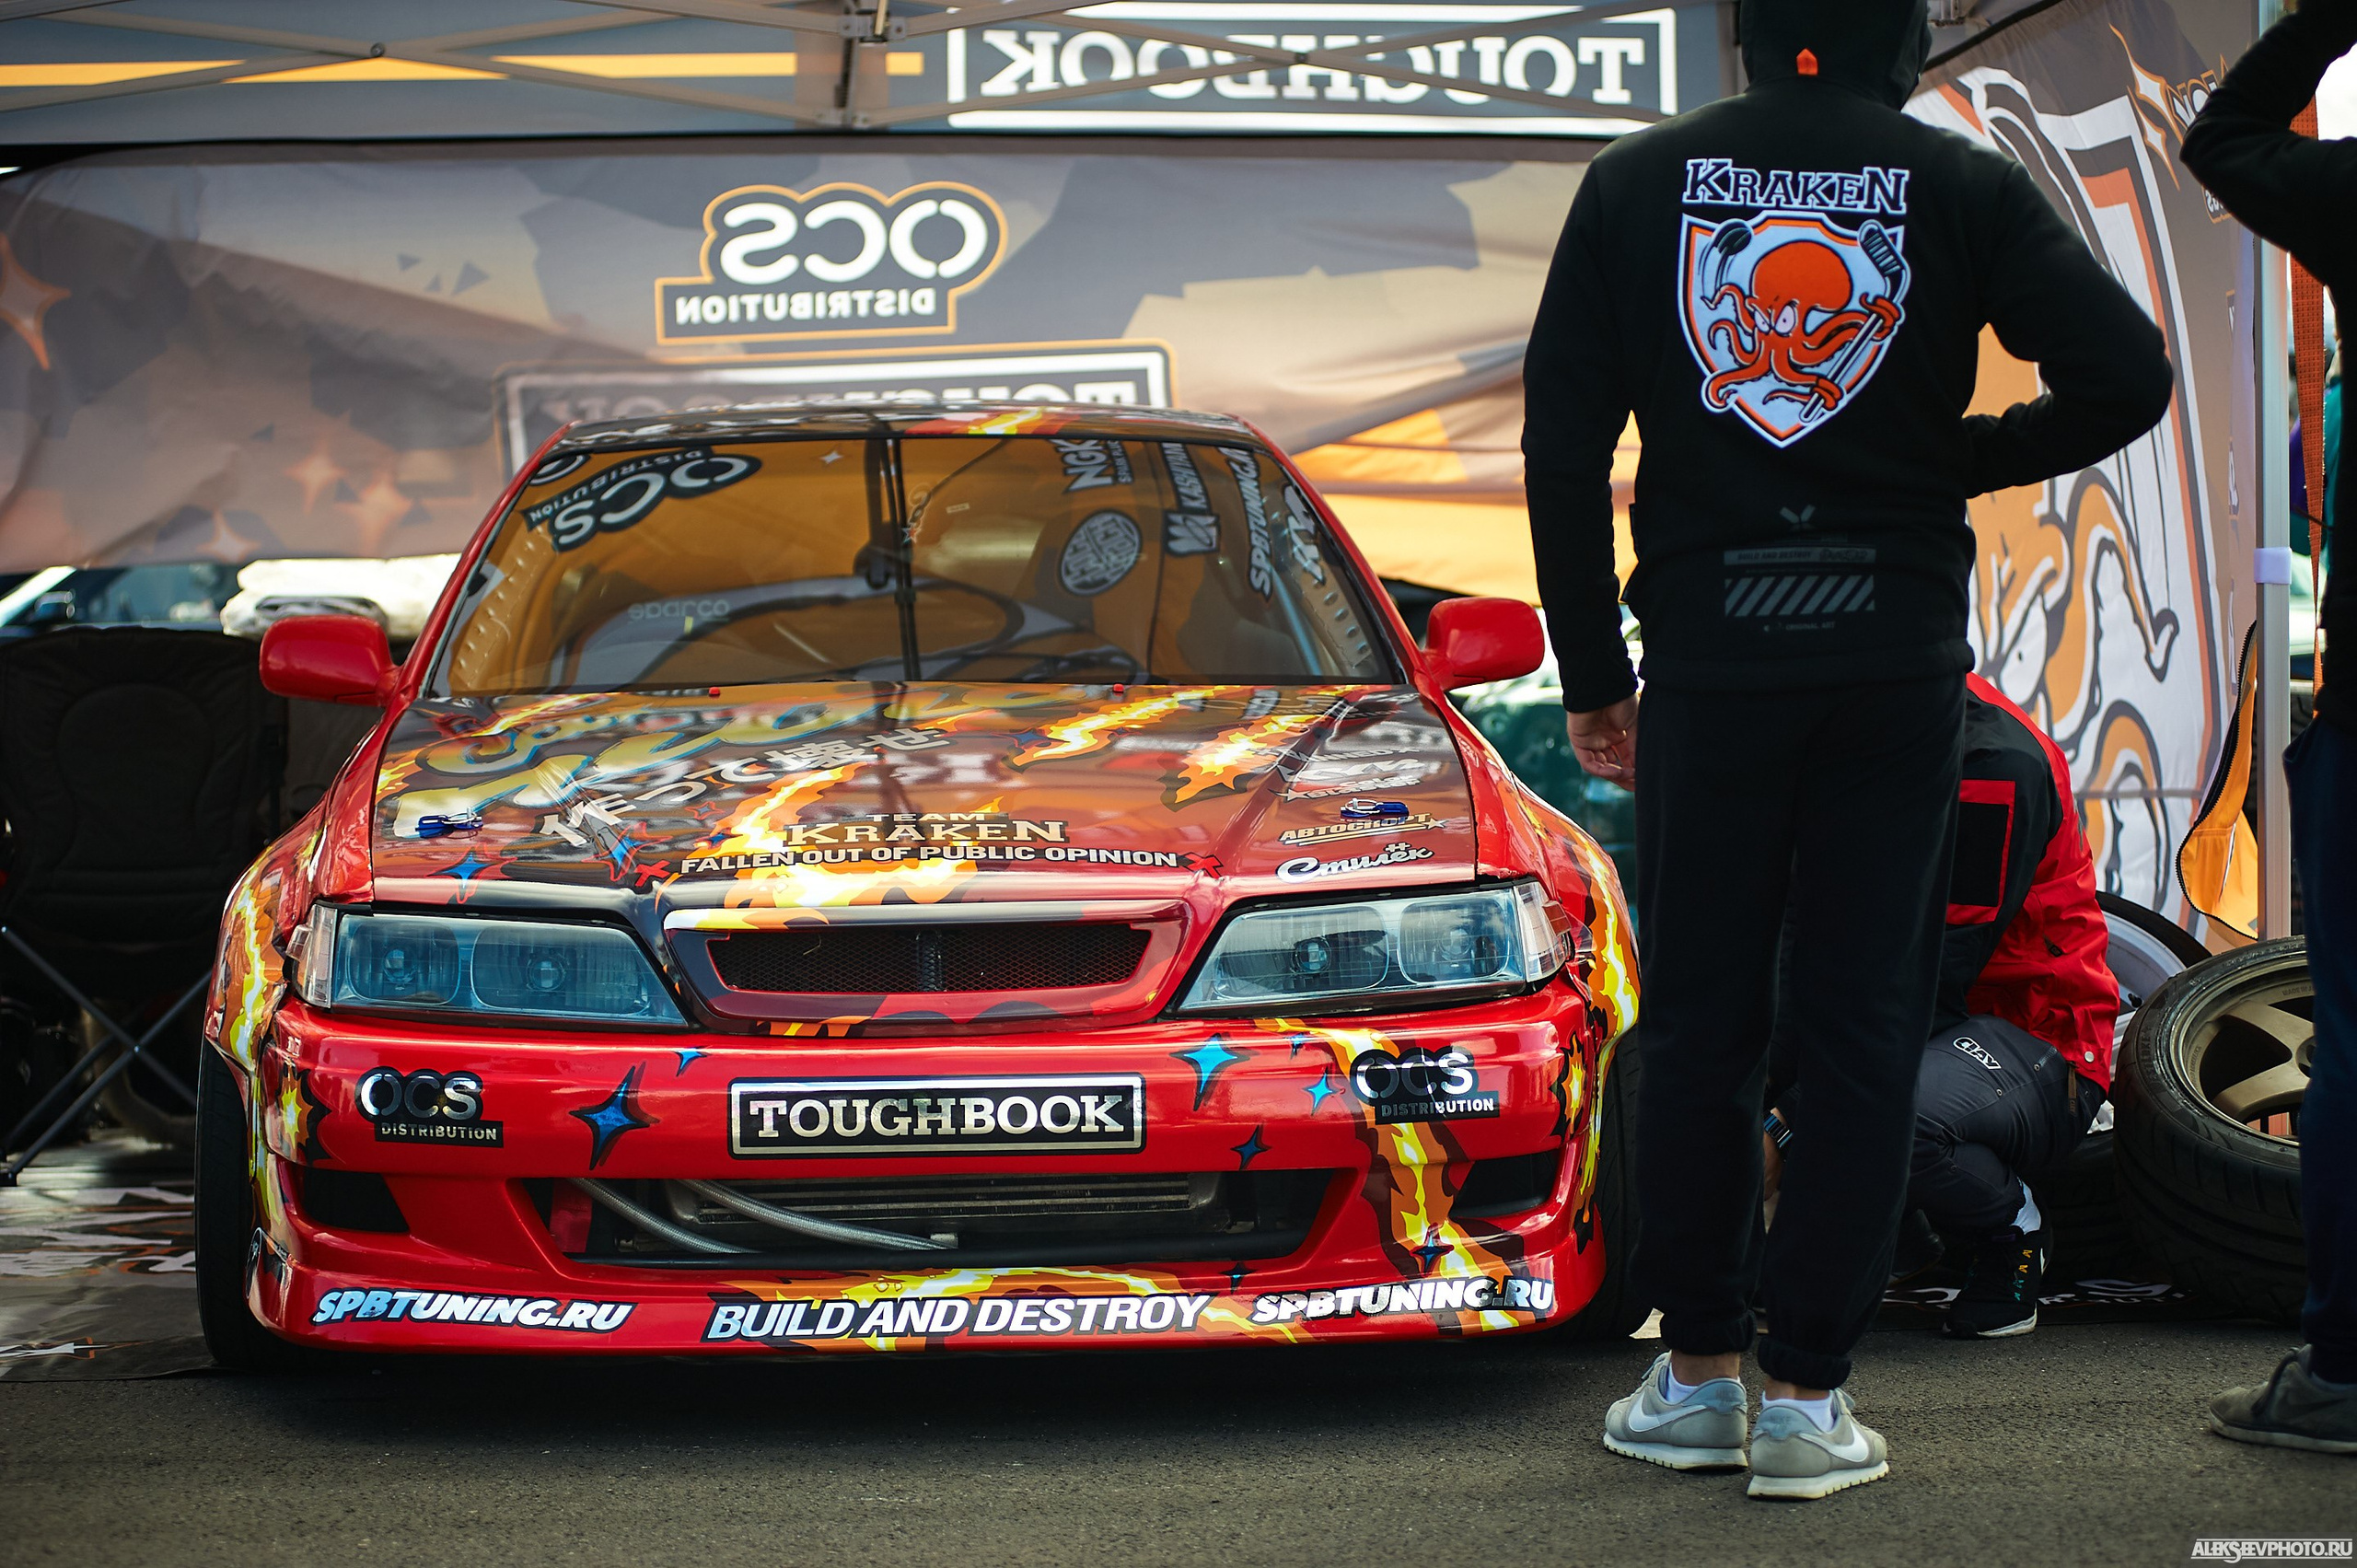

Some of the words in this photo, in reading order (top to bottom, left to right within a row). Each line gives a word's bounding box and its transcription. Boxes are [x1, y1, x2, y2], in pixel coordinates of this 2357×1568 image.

[1682, 157, 1910, 215] KRAKEN
[529, 449, 704, 522] DISTRIBUTION
[554, 457, 749, 545] OCS
[785, 819, 1066, 846] KRAKEN
[868, 811, 985, 822] TEAM
[681, 852, 794, 874] FALLEN
[802, 847, 872, 865] OUT
[877, 846, 914, 862] OF
[920, 845, 1041, 861] PUBLIC
[1045, 848, 1178, 868] OPINION
[361, 1073, 477, 1120] OCS
[1356, 1051, 1473, 1099] OCS
[749, 1095, 1124, 1138] TOUGHBOOK
[1382, 1098, 1494, 1117] DISTRIBUTION
[381, 1121, 497, 1141] DISTRIBUTION
[312, 1290, 633, 1330] SPBTUNING.RU
[707, 1299, 856, 1341] BUILD
[856, 1298, 970, 1335] AND
[974, 1295, 1213, 1334] DESTROY
[1250, 1278, 1553, 1323] SPBTUNING.RU
